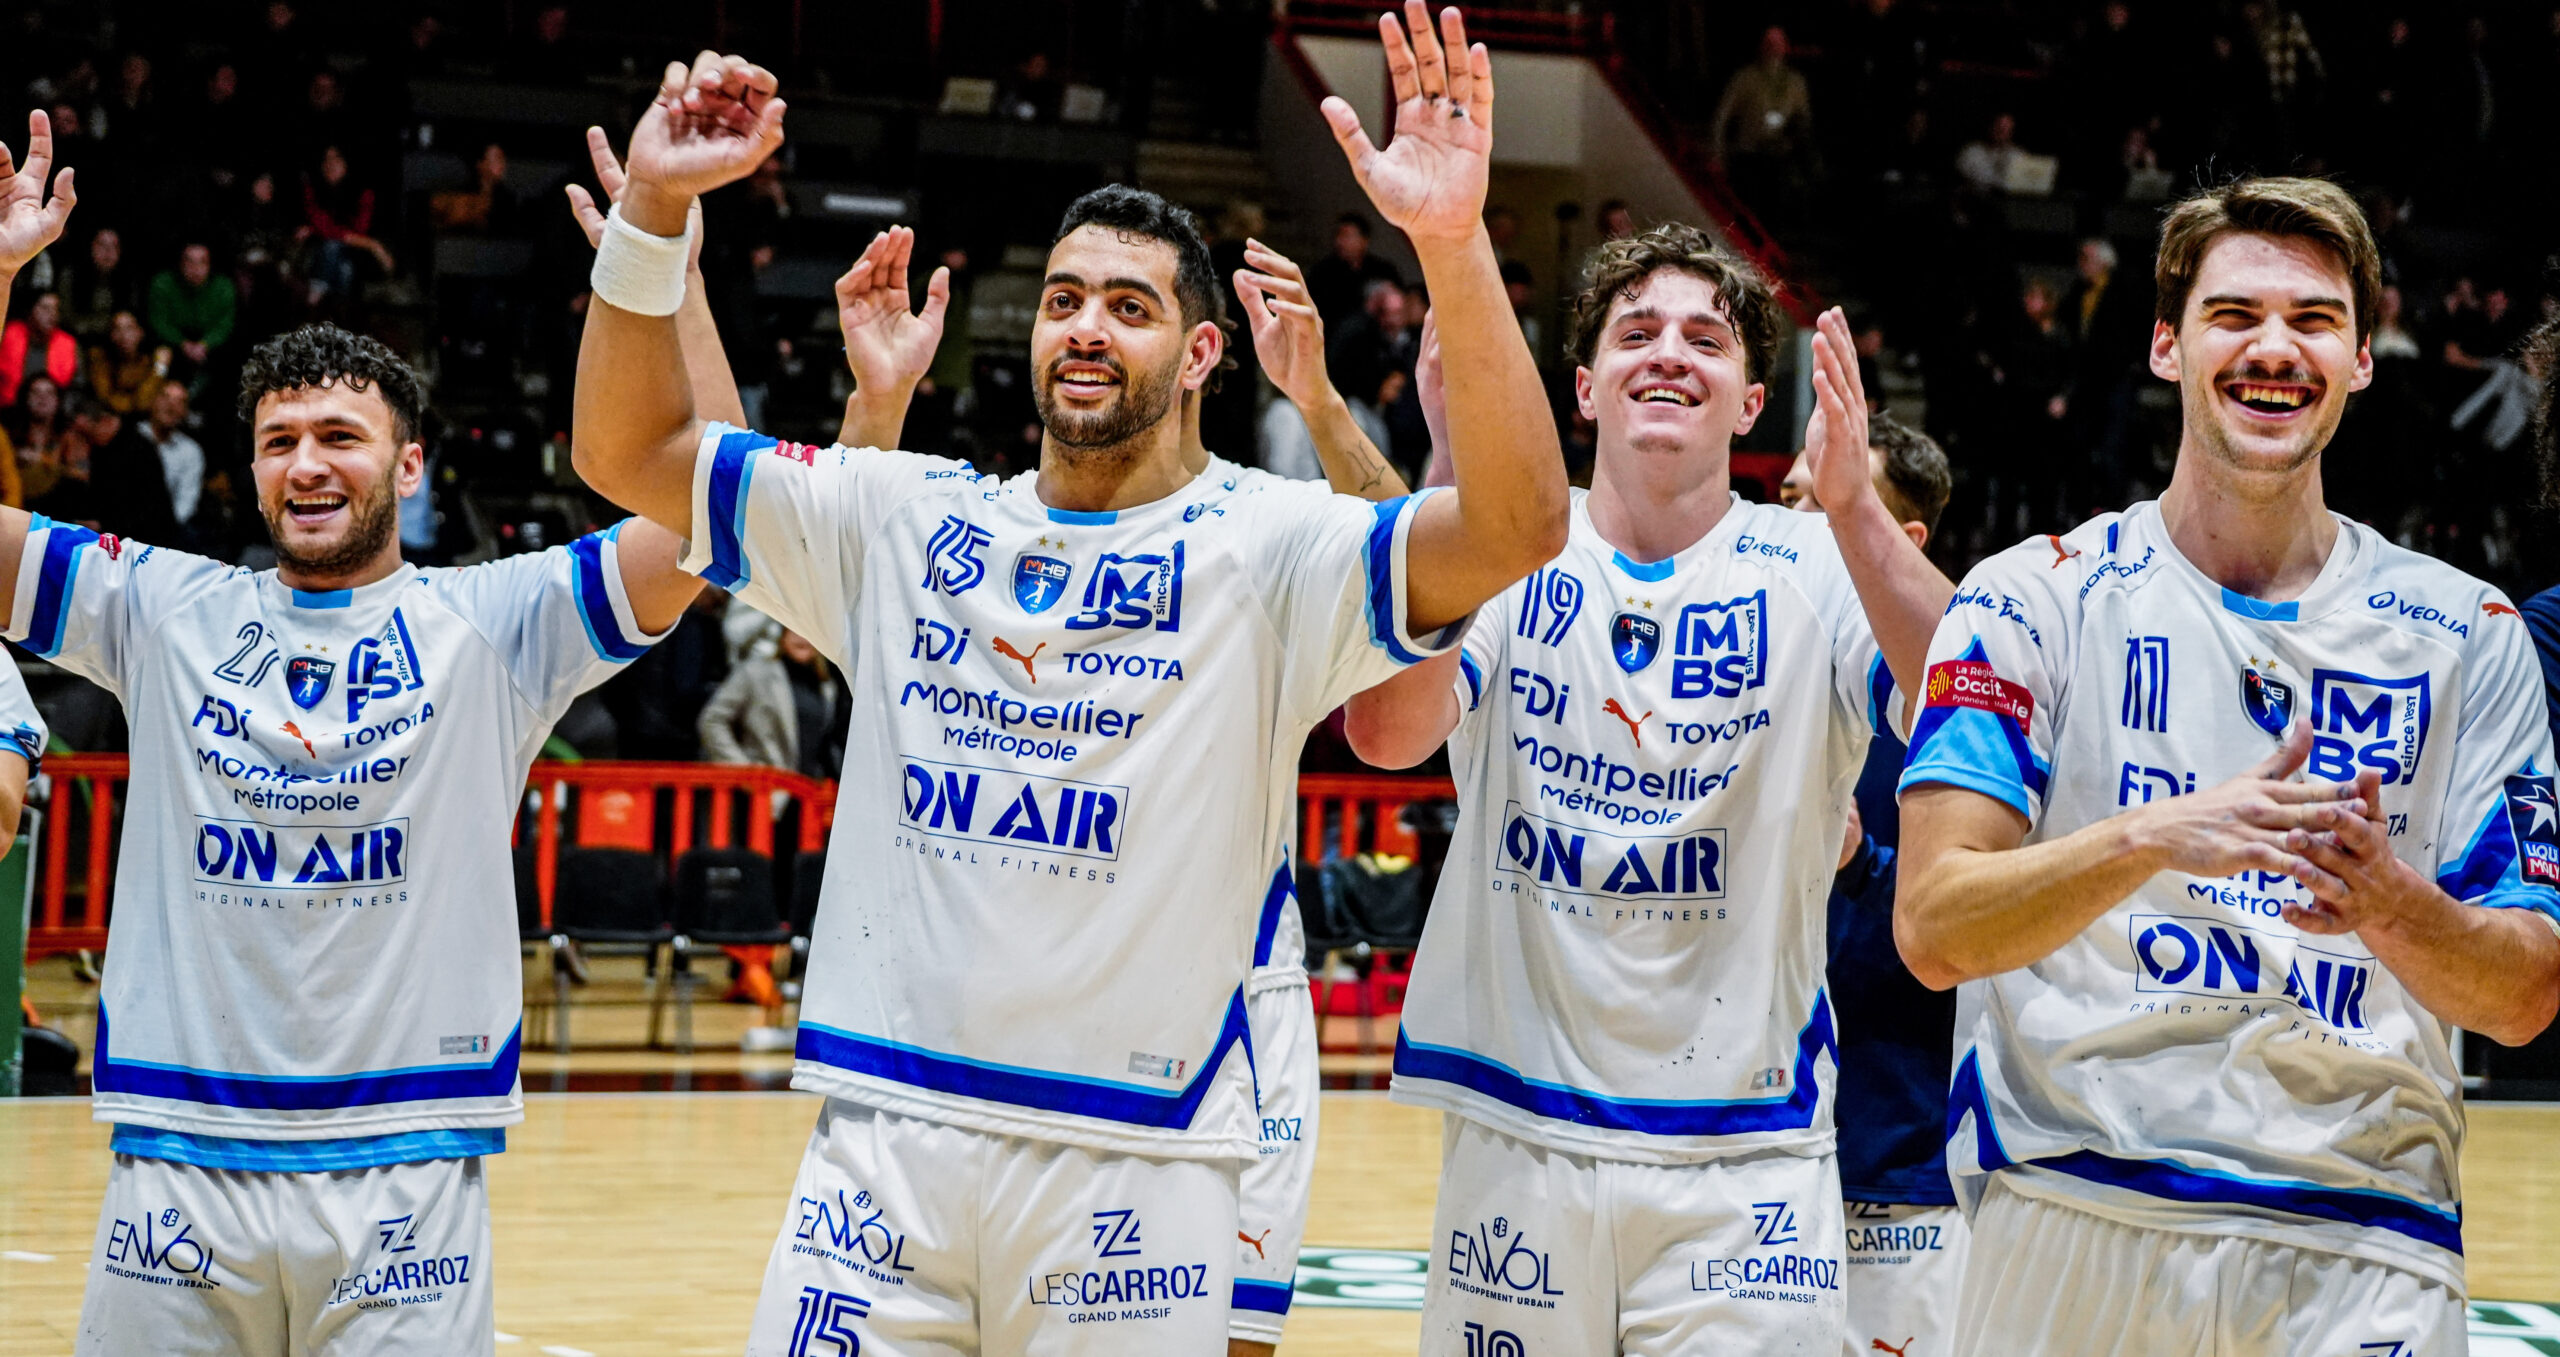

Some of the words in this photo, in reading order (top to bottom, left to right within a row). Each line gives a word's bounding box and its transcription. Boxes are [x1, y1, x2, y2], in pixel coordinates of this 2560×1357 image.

[921, 514, 995, 597] 15
[1025, 560, 1067, 577] MHB
[1517, 567, 1584, 648] 19
[2399, 600, 2469, 639] VEOLIA
[293, 660, 333, 674] MHB
[394, 648, 410, 681] since
[1063, 653, 1184, 681] TOYOTA
[1956, 665, 1968, 675] La
[1970, 667, 1996, 678] Régio
[900, 681, 1144, 739] Montpellier
[1954, 676, 2029, 718] Occitie
[340, 702, 434, 748] TOYOTA
[944, 725, 1077, 761] Métropole
[1666, 709, 1770, 744] TOYOTA
[1513, 731, 1739, 801] Montpellier
[2401, 726, 2415, 768] since
[234, 787, 360, 814] Métropole
[903, 764, 981, 833] ON
[988, 782, 1118, 854] AIR
[1541, 784, 1682, 825] Métropole
[197, 824, 277, 882] ON
[292, 826, 403, 882] AIR
[895, 836, 978, 864] ORIGNAL
[1001, 857, 1115, 884] FITNESS
[1506, 815, 1585, 888] ON
[1600, 837, 1721, 894] AIR
[195, 891, 285, 909] RIGINAL
[307, 891, 408, 909] FITNESS
[1492, 880, 1593, 917] ORIGINAL
[1616, 909, 1727, 920] FITNESS
[2137, 923, 2260, 994] ON
[2282, 956, 2368, 1028] AIR
[2130, 1004, 2267, 1018] ORIGNAL
[1846, 1226, 1943, 1251] CARROZ
[105, 1264, 174, 1286] DÉVELOPPEMENT
[177, 1279, 214, 1291] URBAIN
[793, 1244, 866, 1273] DÉVELOPPEMENT
[869, 1269, 904, 1286] URBAIN
[1449, 1222, 1564, 1295] ENVOL
[1878, 1256, 1912, 1265] MASSIF
[357, 1298, 398, 1310] GRAND
[401, 1293, 443, 1306] MASSIF
[1450, 1278, 1514, 1303] DÉVELOPPEMENT
[1517, 1296, 1555, 1309] URBAIN
[1729, 1288, 1775, 1301] GRAND
[1779, 1292, 1817, 1304] MASSIF
[788, 1285, 872, 1357] 15
[1069, 1311, 1117, 1324] GRAND
[1121, 1307, 1172, 1320] MASSIF
